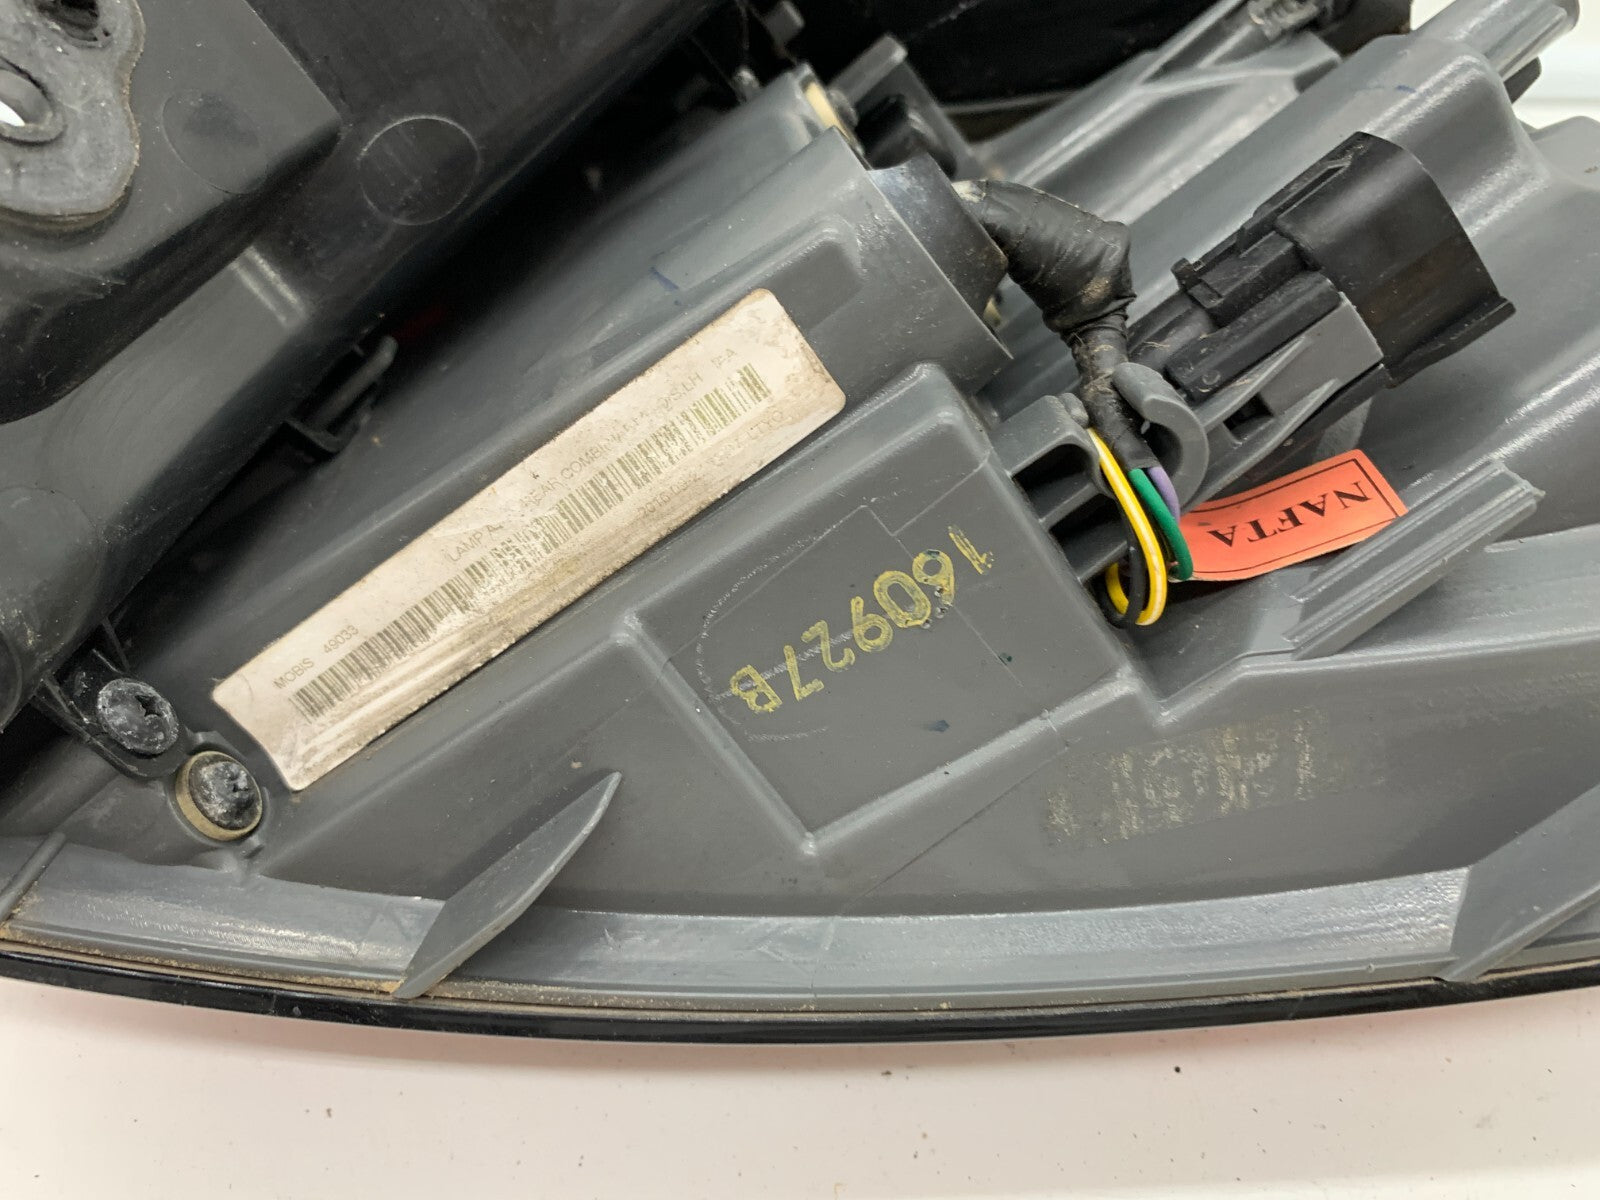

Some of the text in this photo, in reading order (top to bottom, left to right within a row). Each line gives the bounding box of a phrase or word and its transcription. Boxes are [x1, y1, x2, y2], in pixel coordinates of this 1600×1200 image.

[1207, 482, 1370, 548] NAFTA
[273, 655, 316, 690] MOBIS
[320, 623, 360, 655] 49033
[447, 529, 487, 562] LAMP
[730, 526, 995, 714] 160927B
